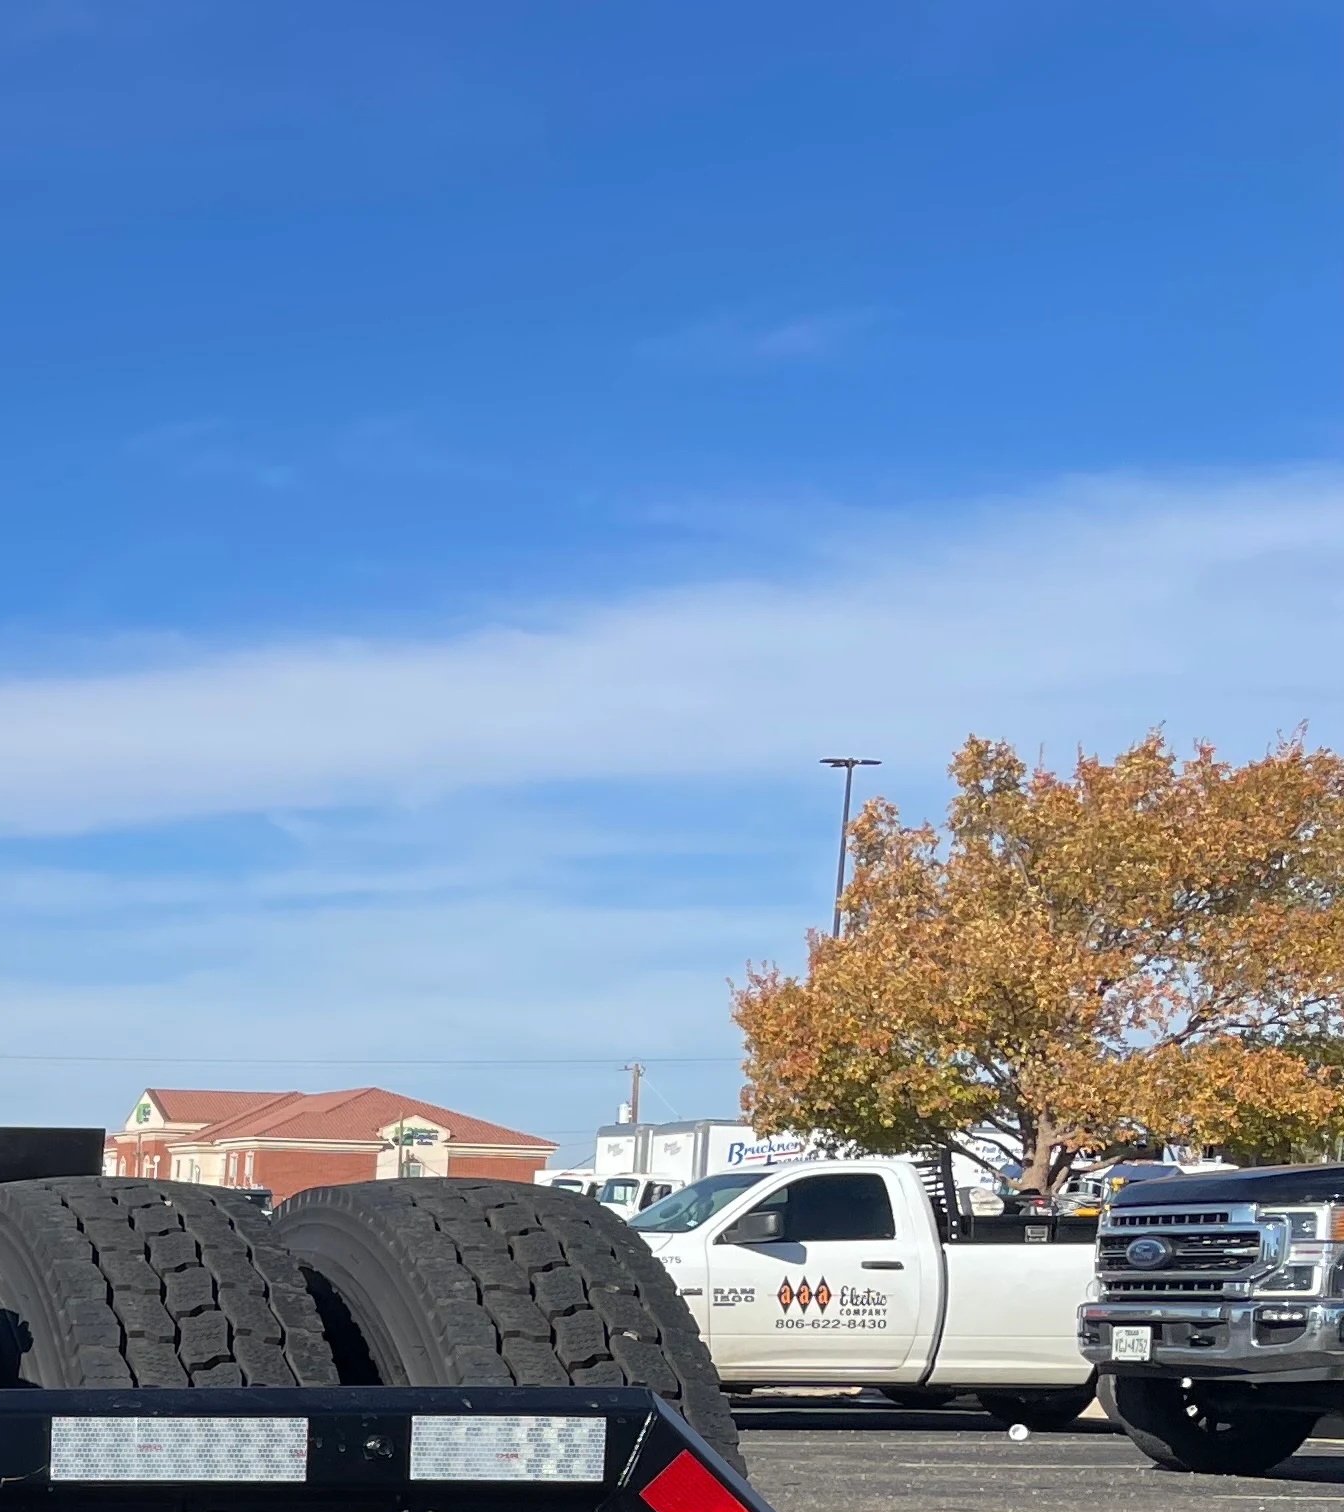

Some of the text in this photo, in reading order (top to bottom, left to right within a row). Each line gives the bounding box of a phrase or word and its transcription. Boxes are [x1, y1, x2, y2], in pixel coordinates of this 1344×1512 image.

[713, 1295, 755, 1303] 1500
[839, 1285, 887, 1306] Electric
[839, 1308, 887, 1316] COMPANY
[775, 1318, 887, 1330] 806-622-8430
